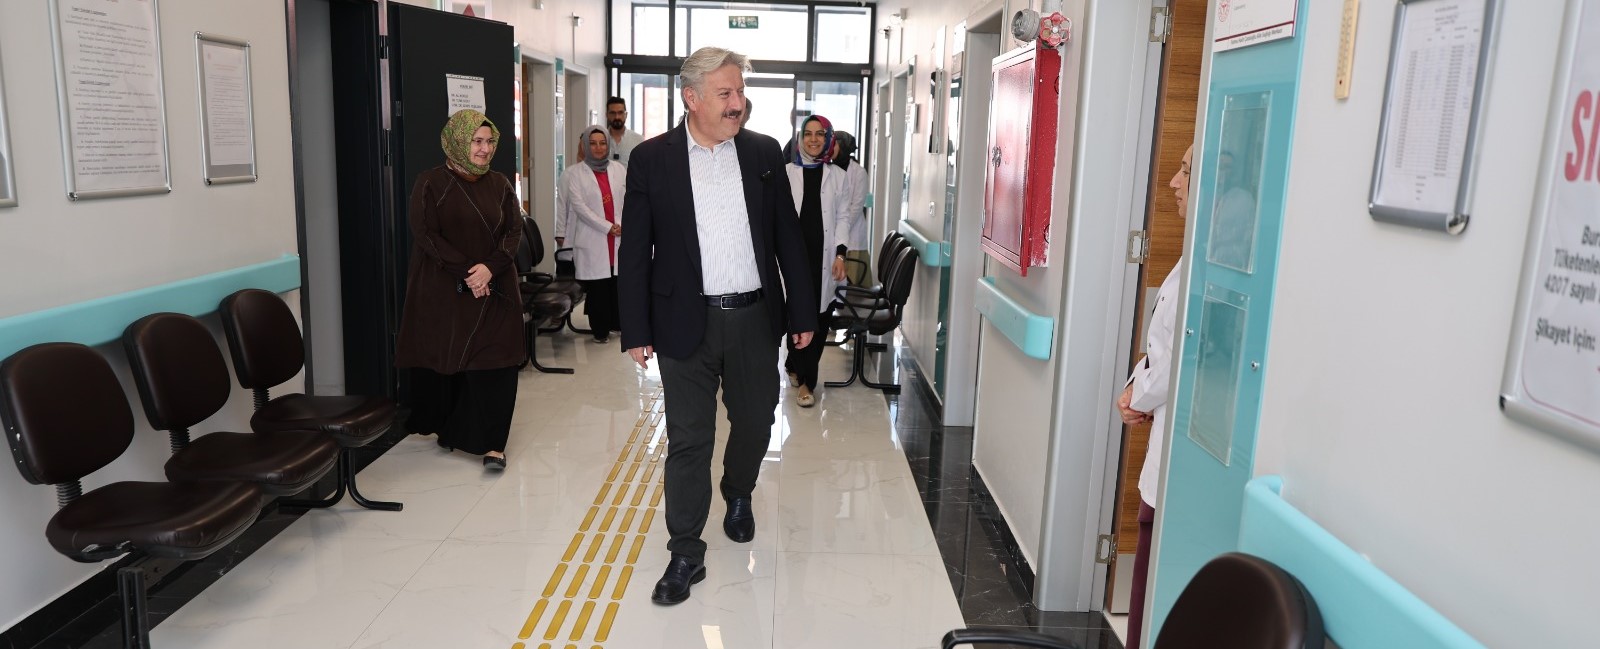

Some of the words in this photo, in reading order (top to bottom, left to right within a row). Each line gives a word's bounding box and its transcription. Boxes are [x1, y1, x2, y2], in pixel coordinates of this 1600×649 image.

[1564, 89, 1600, 182] SI
[1554, 248, 1600, 275] Tüketenle
[1544, 274, 1569, 296] 4207
[1570, 281, 1596, 304] sayılı
[1536, 317, 1571, 346] Şikayet
[1573, 326, 1596, 353] için:
